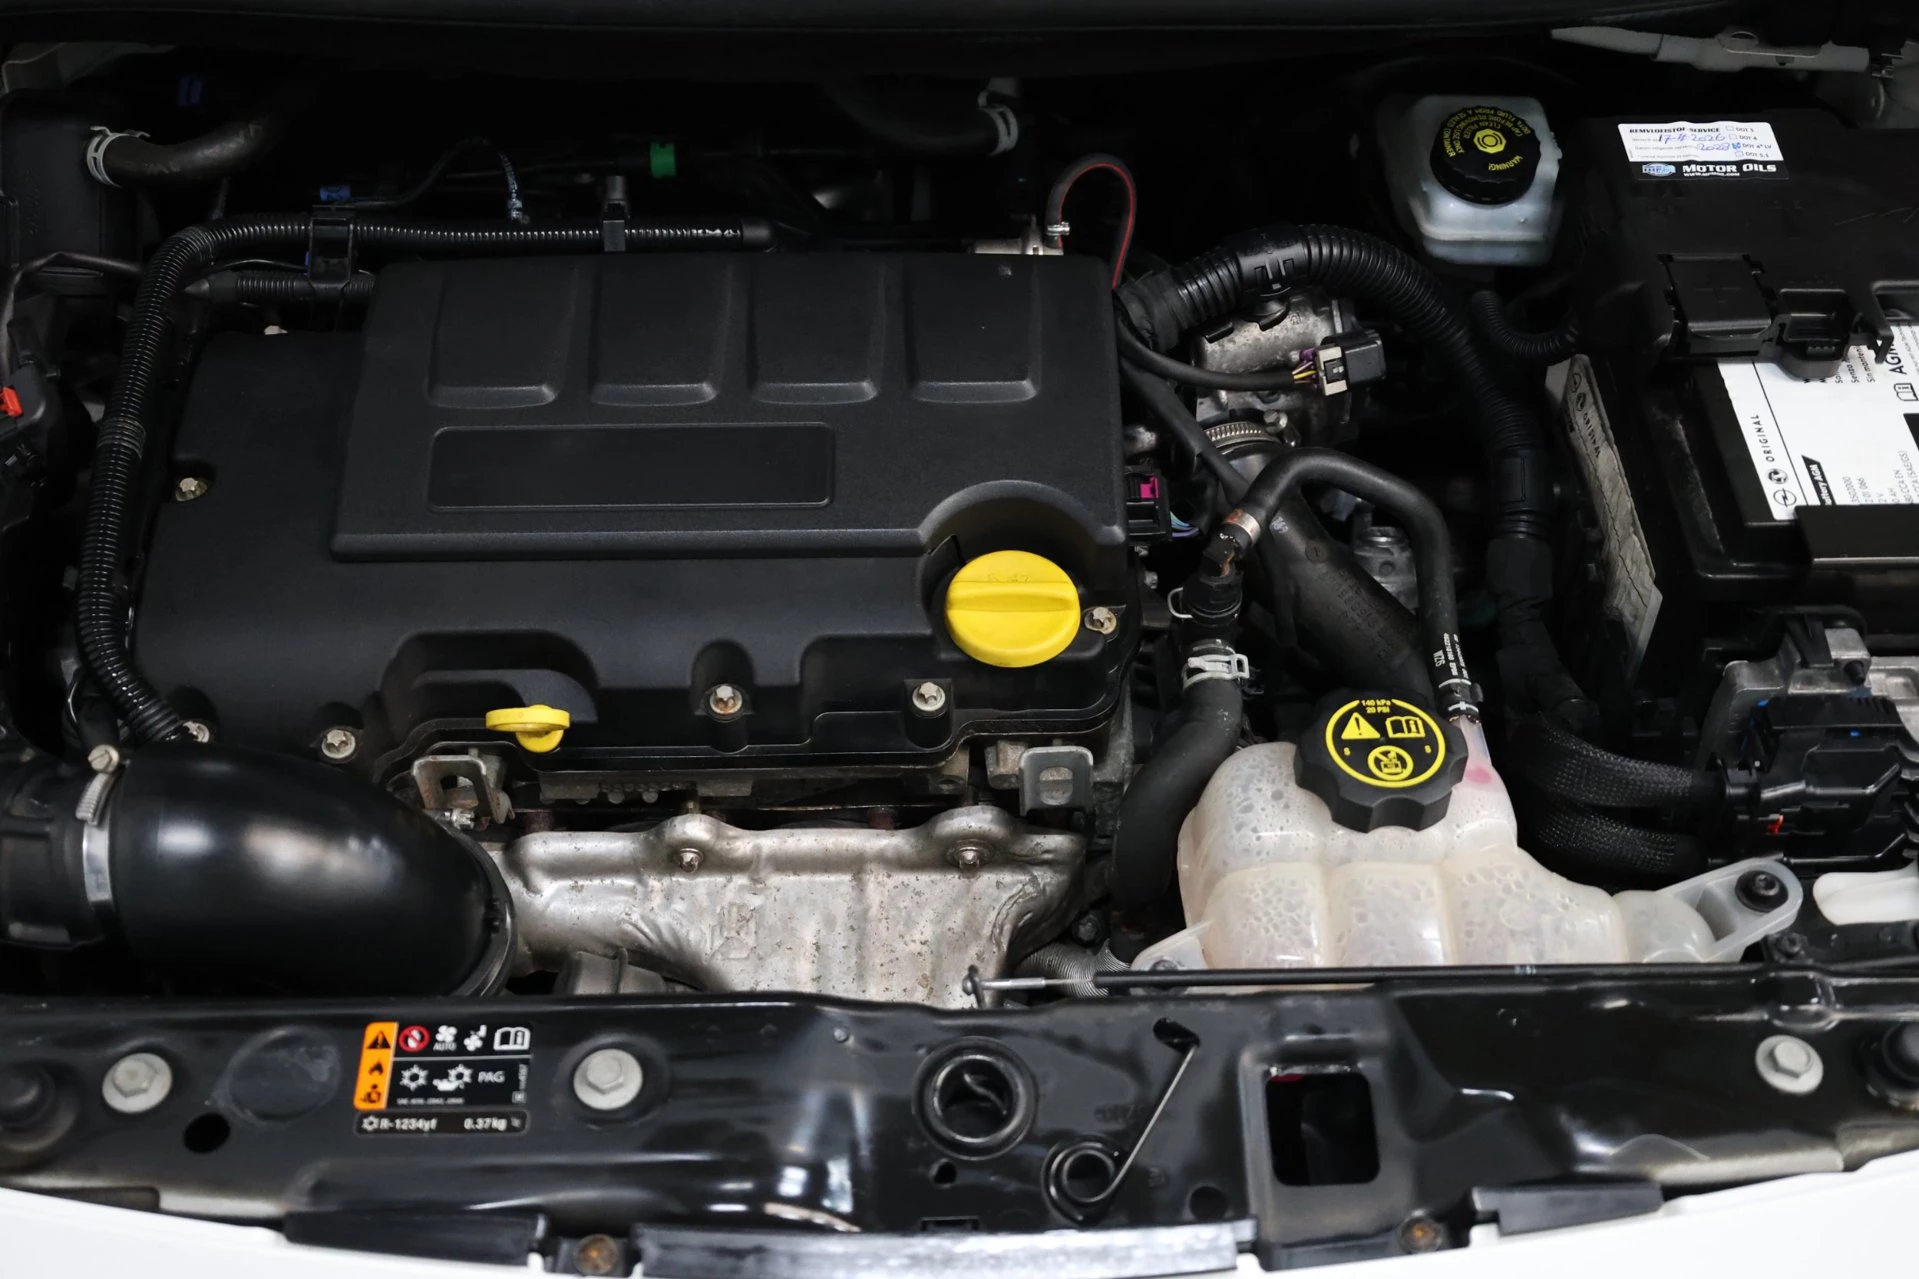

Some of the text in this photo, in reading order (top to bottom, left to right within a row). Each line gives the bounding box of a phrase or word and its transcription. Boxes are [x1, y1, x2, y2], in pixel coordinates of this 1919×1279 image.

[1487, 115, 1513, 128] BEFORE
[1496, 110, 1515, 122] FLUID
[1479, 121, 1502, 129] CLEAN
[1443, 128, 1456, 157] CONTAINER
[1487, 154, 1524, 172] WARNING!
[1682, 163, 1777, 173] MOTOR OILS
[1864, 372, 1876, 384] Sin
[1750, 414, 1775, 462] ORIGINAL
[1809, 464, 1824, 482] AGM
[1361, 699, 1392, 707] 140 kPa
[1365, 706, 1390, 714] 20 PSI
[433, 1042, 457, 1051] AUTO
[477, 1071, 506, 1083] PAG
[379, 1117, 437, 1131] R-1234yf
